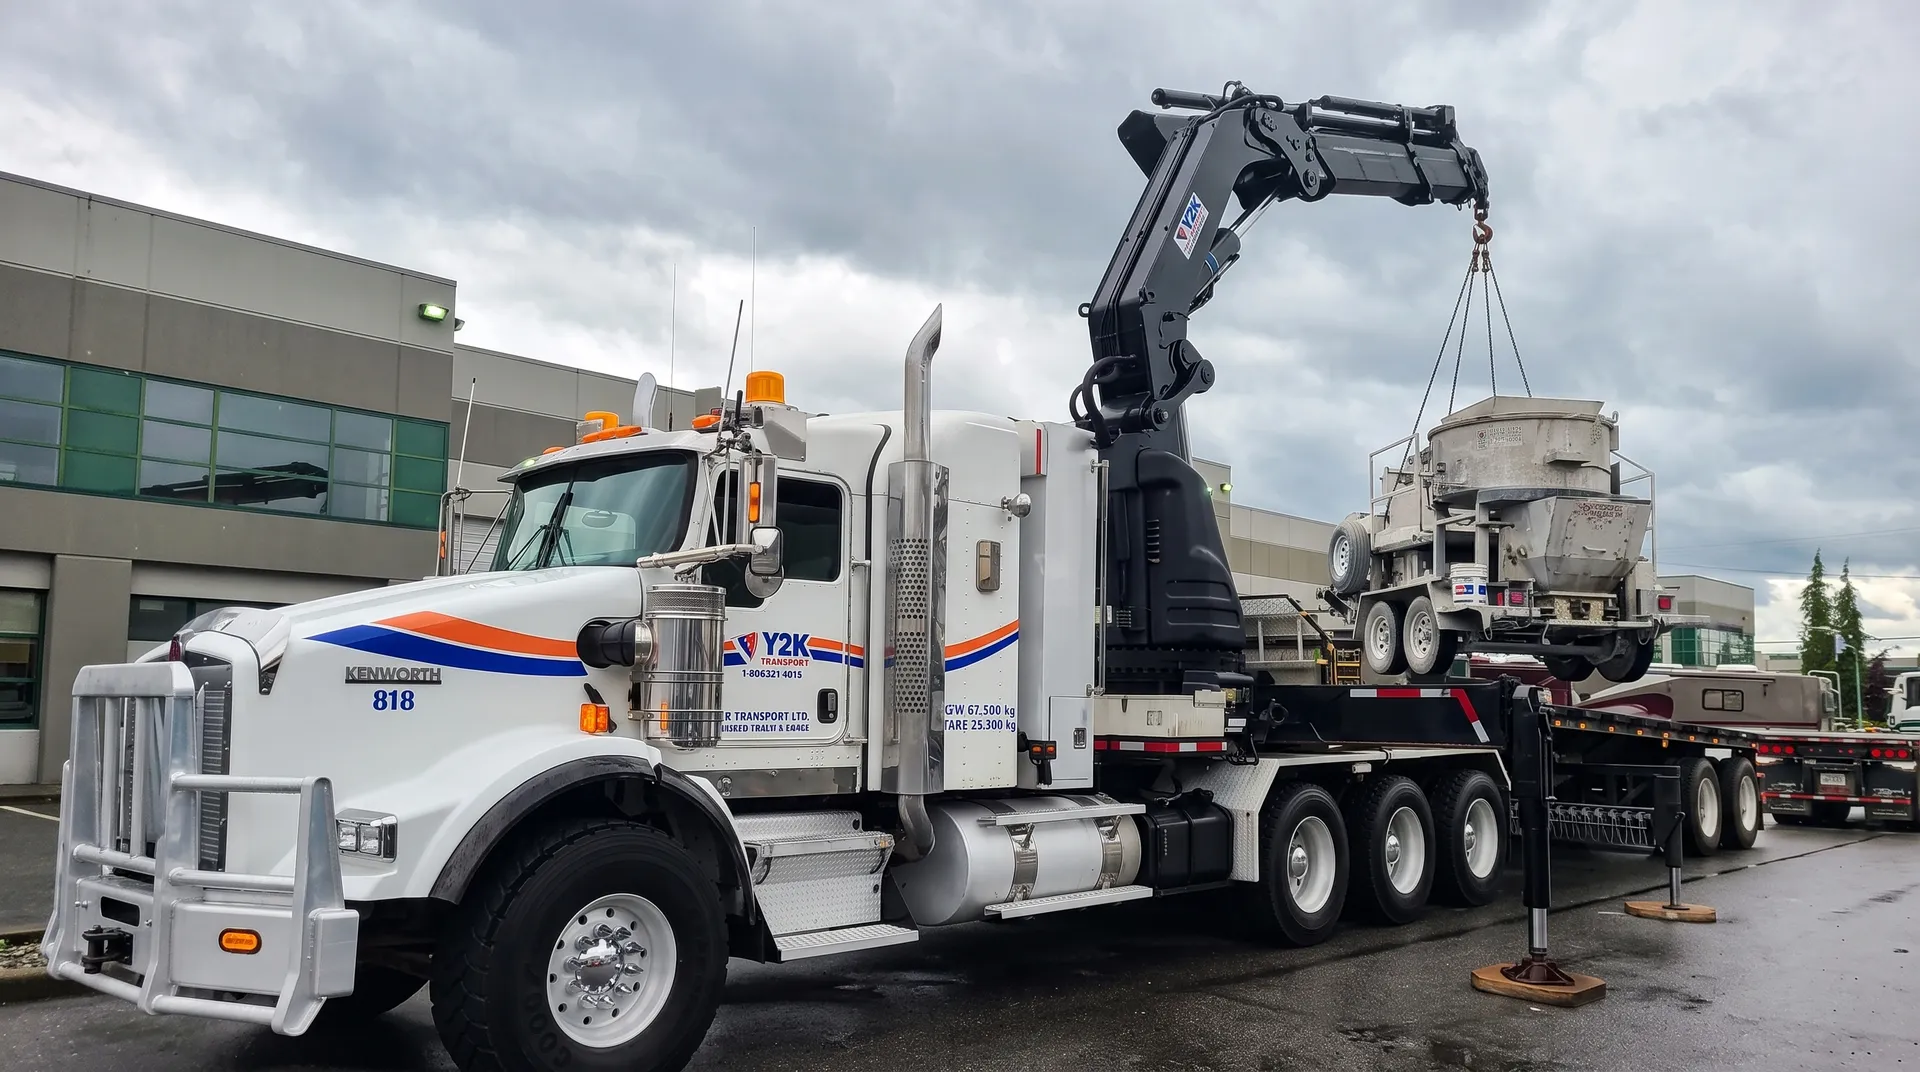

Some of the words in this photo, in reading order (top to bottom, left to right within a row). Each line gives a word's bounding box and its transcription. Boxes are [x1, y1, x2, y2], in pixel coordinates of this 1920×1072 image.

[1181, 195, 1202, 229] Y2K
[762, 632, 810, 657] Y2K
[761, 657, 809, 666] TRANSPORT
[345, 666, 441, 681] KENWORTH
[782, 671, 802, 679] 4015
[373, 690, 415, 711] 818
[734, 711, 789, 721] TRANSPORT
[791, 711, 810, 721] LTD.
[1004, 704, 1015, 718] kg
[944, 719, 968, 730] TARE
[971, 719, 1003, 730] 25.300
[1005, 719, 1016, 732] kg
